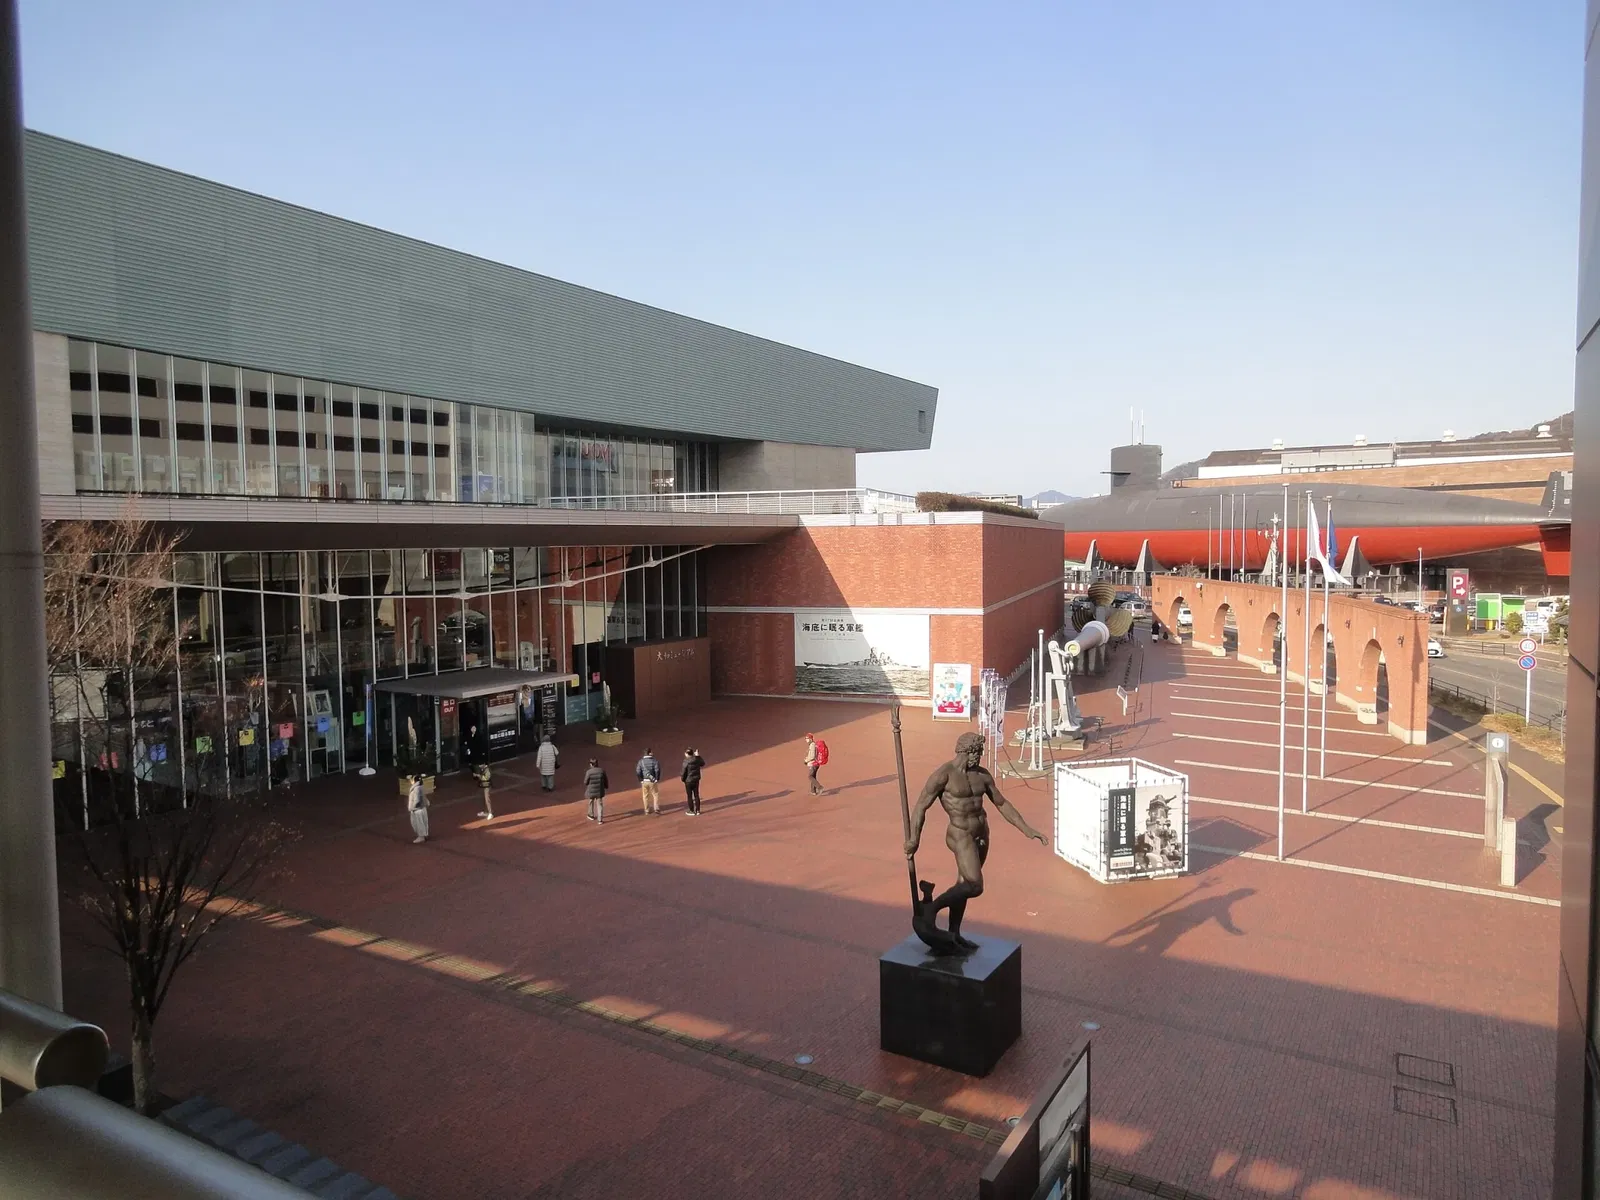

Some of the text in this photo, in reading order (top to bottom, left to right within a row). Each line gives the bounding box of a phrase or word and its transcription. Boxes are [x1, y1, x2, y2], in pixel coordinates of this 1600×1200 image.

[1452, 576, 1464, 589] P
[801, 623, 864, 632] 海底に眠る軍艦
